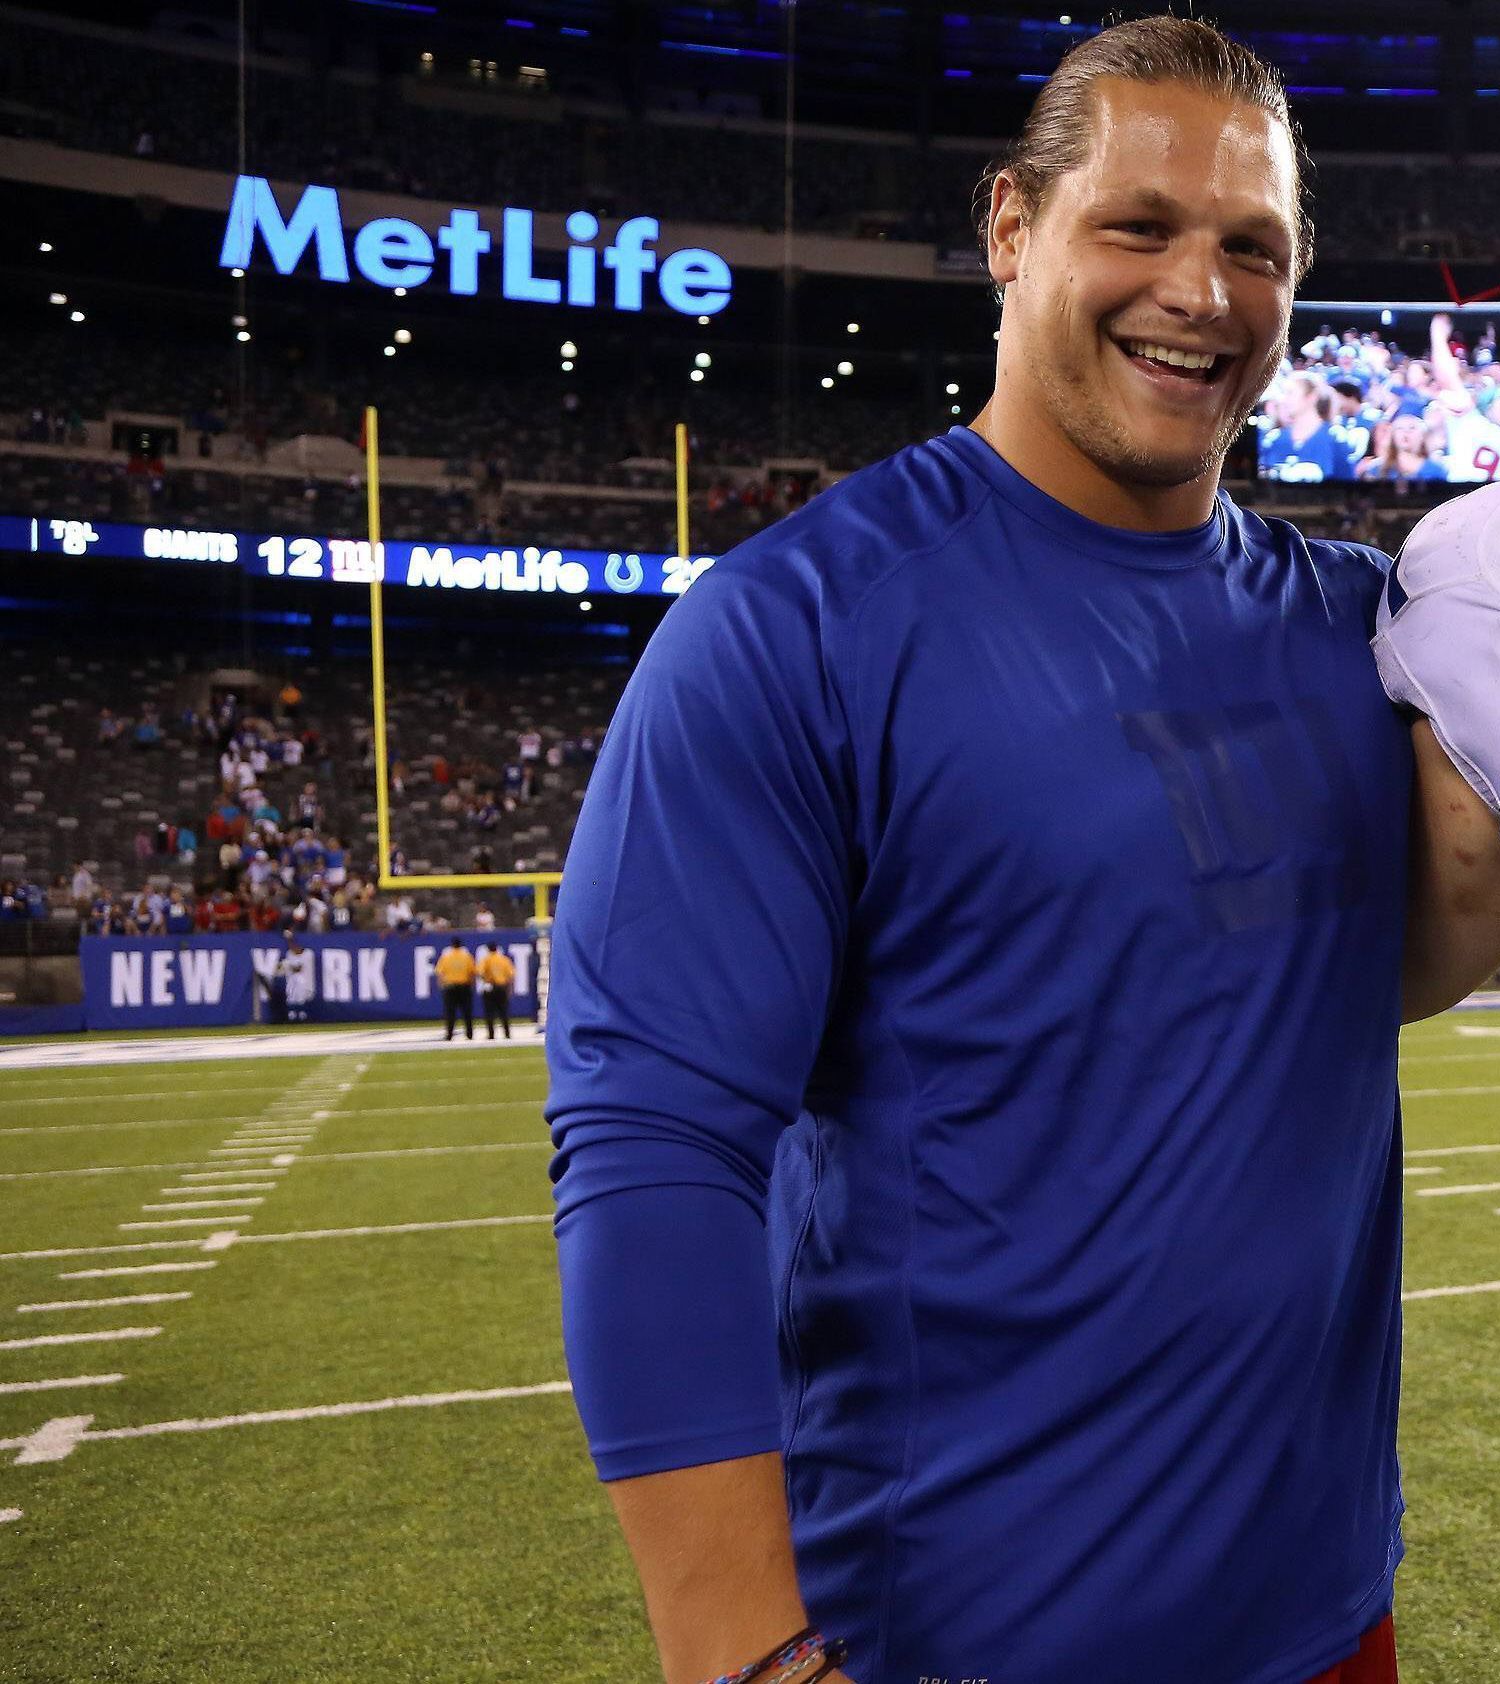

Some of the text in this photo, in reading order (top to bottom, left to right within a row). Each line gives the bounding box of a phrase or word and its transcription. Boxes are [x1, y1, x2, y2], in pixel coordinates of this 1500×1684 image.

[219, 174, 732, 316] MetLife
[144, 528, 238, 563] GIANTS
[258, 536, 323, 577] 12
[406, 547, 589, 594] MetLife
[110, 949, 226, 1007] NEW
